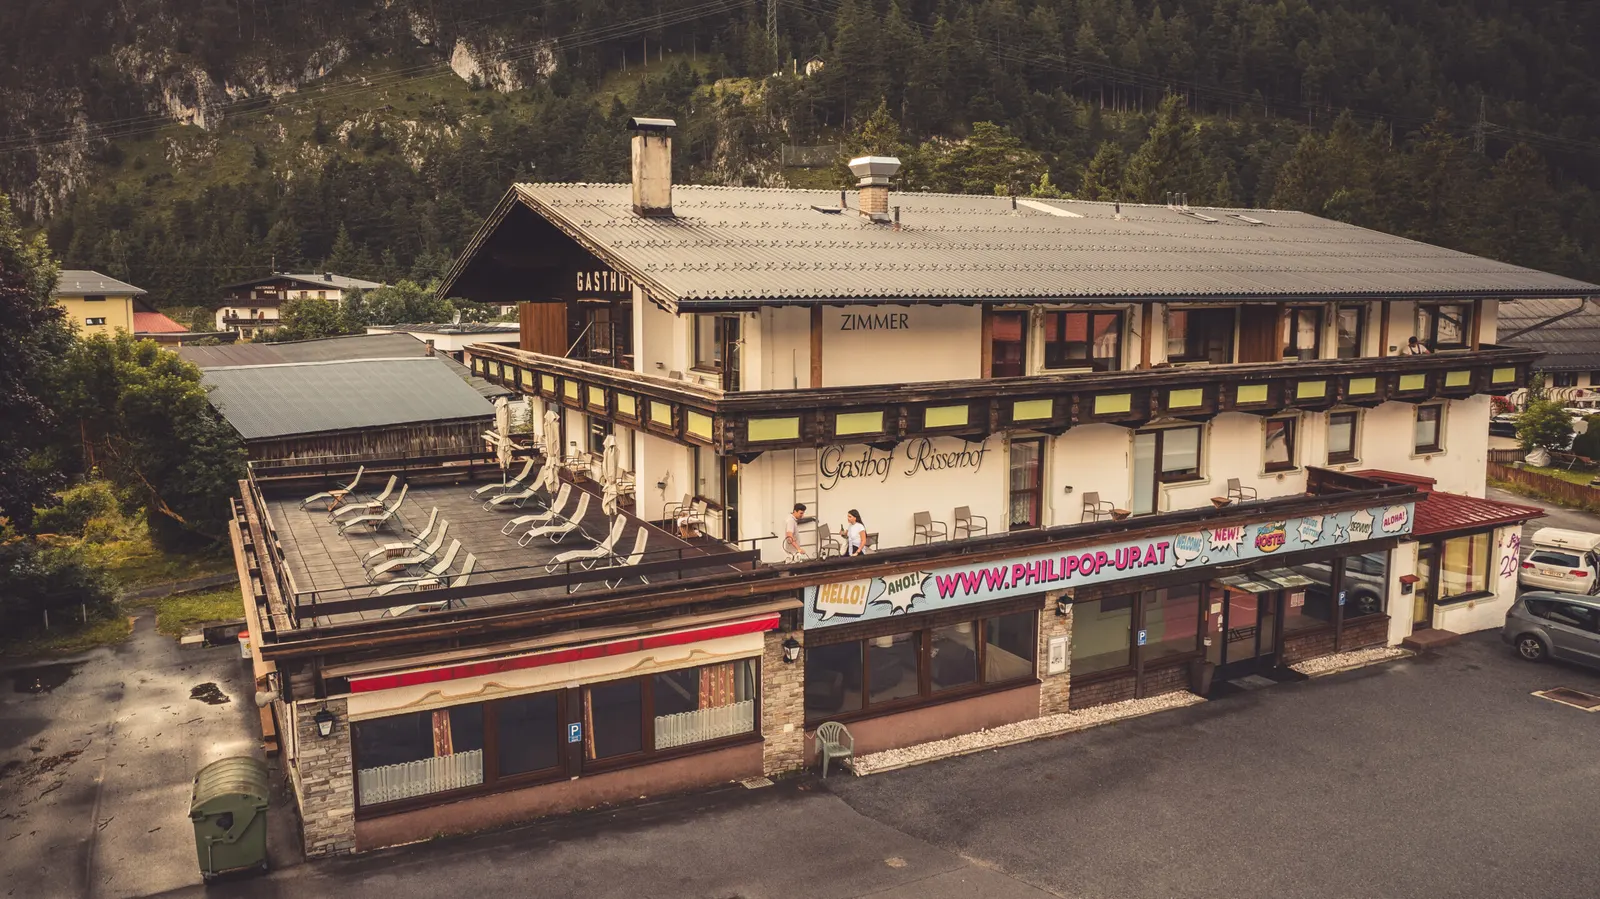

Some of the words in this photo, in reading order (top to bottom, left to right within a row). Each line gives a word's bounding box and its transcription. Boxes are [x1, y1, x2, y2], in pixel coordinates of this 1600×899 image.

[840, 313, 909, 331] ZIMMER
[820, 444, 895, 491] Gasthof
[904, 437, 991, 477] Risserhof
[1383, 511, 1405, 527] ALOHA!
[1214, 527, 1240, 542] NEW!
[1254, 533, 1286, 549] HOSTEL
[935, 541, 1170, 599] WWW.PHILIPOP-UP.AT
[887, 571, 921, 596] AHOI!
[820, 583, 866, 606] HELLO!
[1139, 631, 1146, 641] P
[571, 725, 579, 736] P
